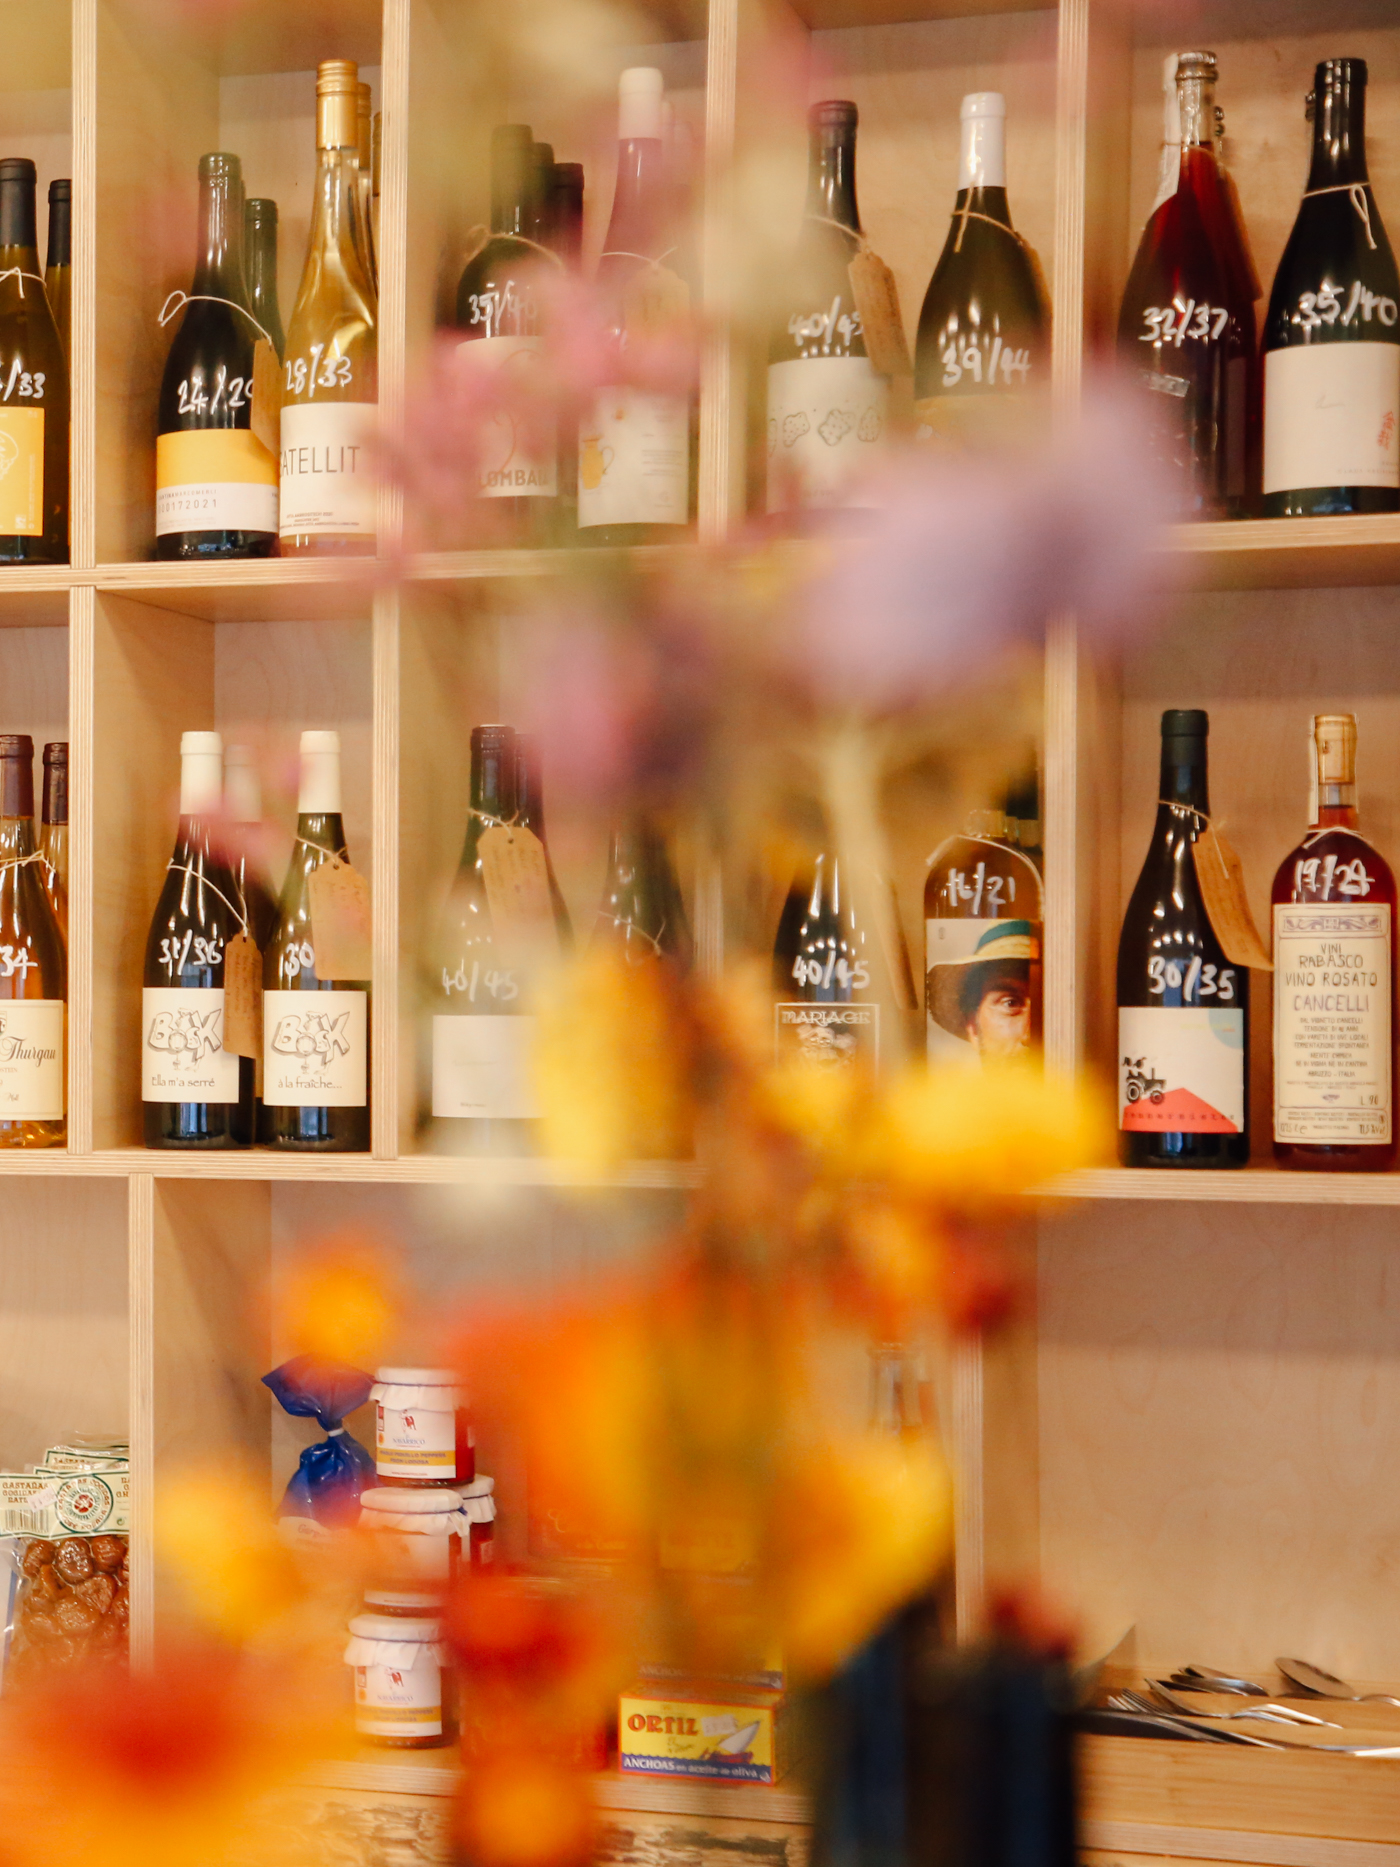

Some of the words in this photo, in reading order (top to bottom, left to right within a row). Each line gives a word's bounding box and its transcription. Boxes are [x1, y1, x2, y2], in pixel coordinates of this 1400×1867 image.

[1298, 280, 1398, 327] 35/40
[1138, 299, 1229, 348] 32/37
[1293, 855, 1375, 901] 19/24
[1321, 943, 1341, 955] VINI
[792, 950, 870, 990] 40/45
[1299, 954, 1364, 969] RABASCO
[442, 960, 518, 1002] 40/45
[1148, 954, 1236, 1002] 30/35
[1286, 972, 1316, 987] VINO
[1323, 972, 1378, 987] ROSATO
[1293, 994, 1370, 1012] CANCELLI
[781, 1010, 871, 1027] MARIAGE
[151, 1076, 166, 1087] Ella
[168, 1077, 185, 1087] m'a
[187, 1077, 215, 1087] serré
[278, 1079, 284, 1089] à
[285, 1077, 294, 1089] la
[627, 1714, 699, 1736] ORTIZ
[623, 1757, 675, 1771] ANCHOAS
[688, 1764, 718, 1775] aceite
[731, 1765, 758, 1778] oliva
